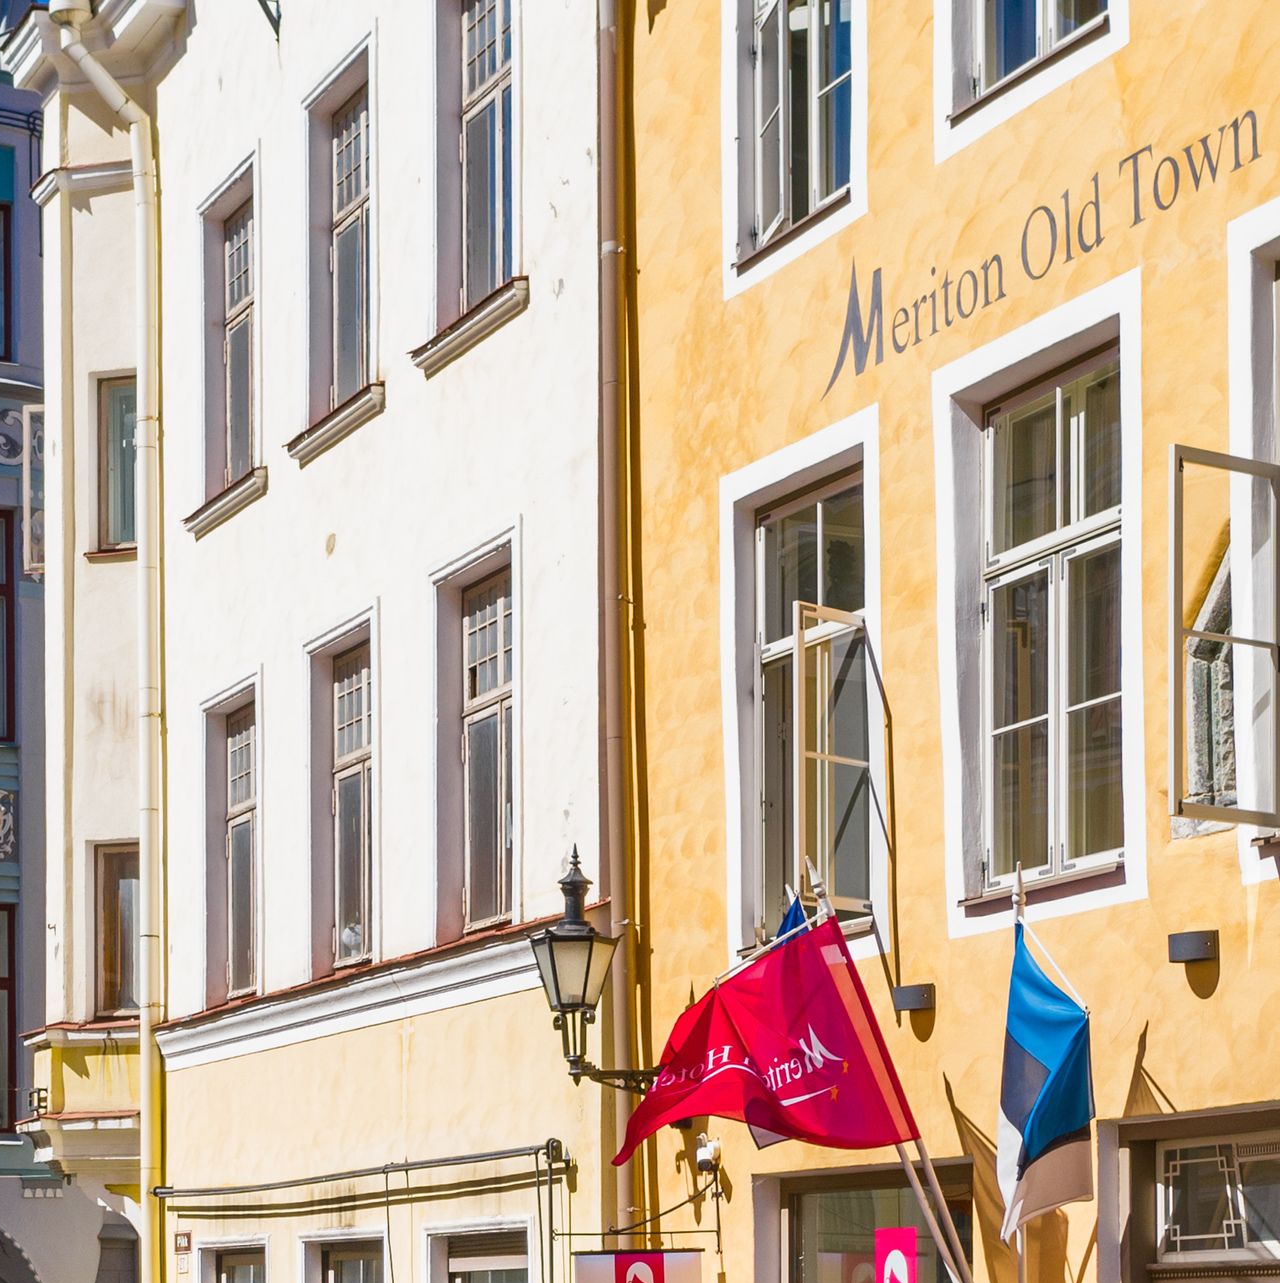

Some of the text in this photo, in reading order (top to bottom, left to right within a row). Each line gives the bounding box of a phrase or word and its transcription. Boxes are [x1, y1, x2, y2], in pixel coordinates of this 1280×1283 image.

[822, 252, 1007, 401] Meriton
[1020, 173, 1105, 281] Old
[1119, 108, 1261, 229] Town
